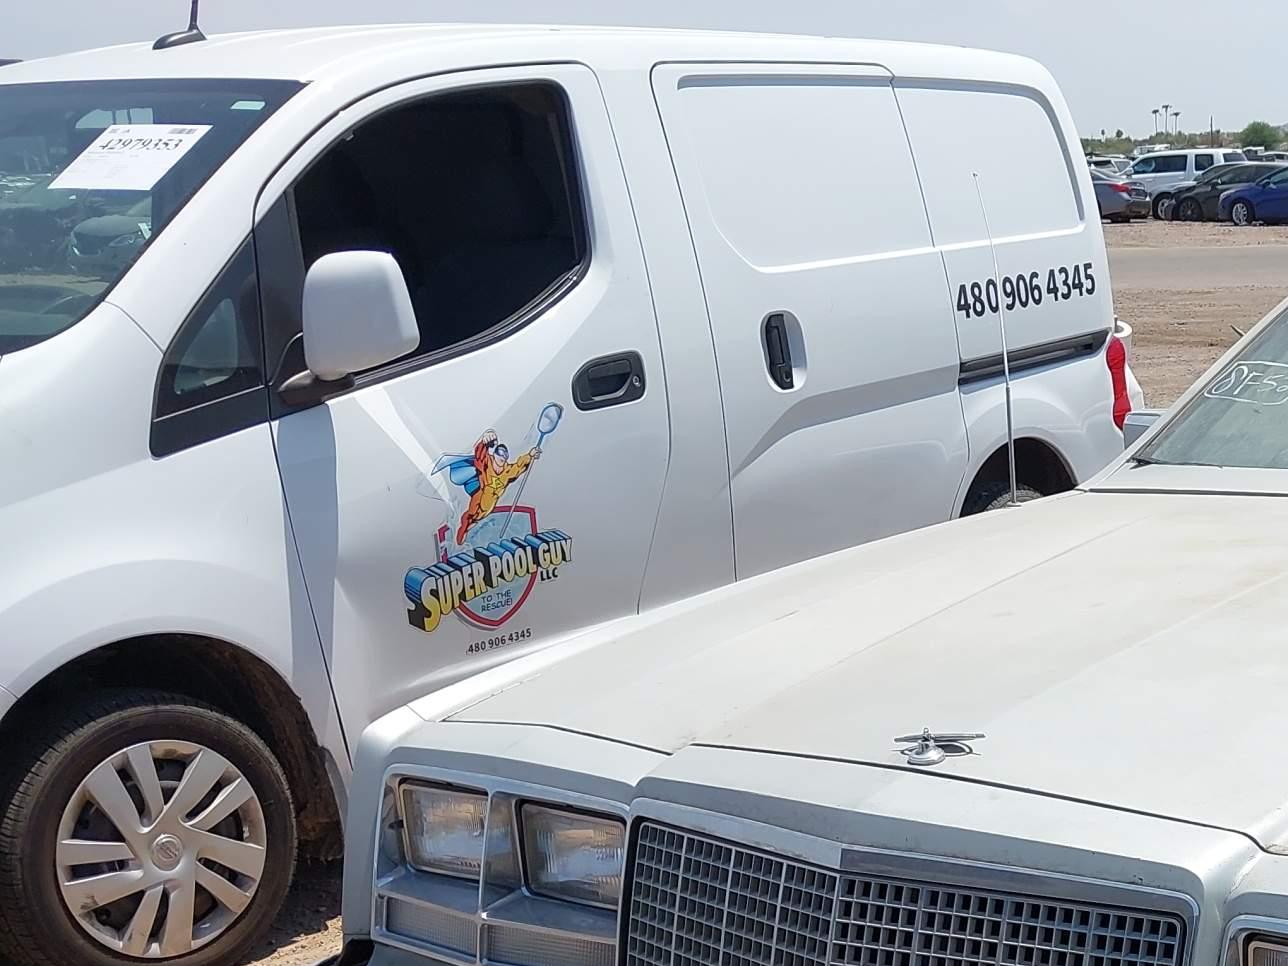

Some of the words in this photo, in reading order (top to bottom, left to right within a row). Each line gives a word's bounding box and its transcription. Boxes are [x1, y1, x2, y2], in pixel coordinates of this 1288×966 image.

[99, 138, 184, 151] 42979353
[956, 277, 1000, 319] 480
[1001, 271, 1043, 311] 906
[1046, 262, 1096, 302] 4345
[412, 556, 487, 632] SUPER
[487, 544, 538, 588] POOL
[536, 536, 573, 570] GUY
[540, 567, 559, 582] LLC
[481, 594, 493, 604] TO
[496, 589, 512, 600] THE
[468, 640, 486, 654] 480
[488, 634, 506, 649] 906
[508, 628, 532, 642] 4345
